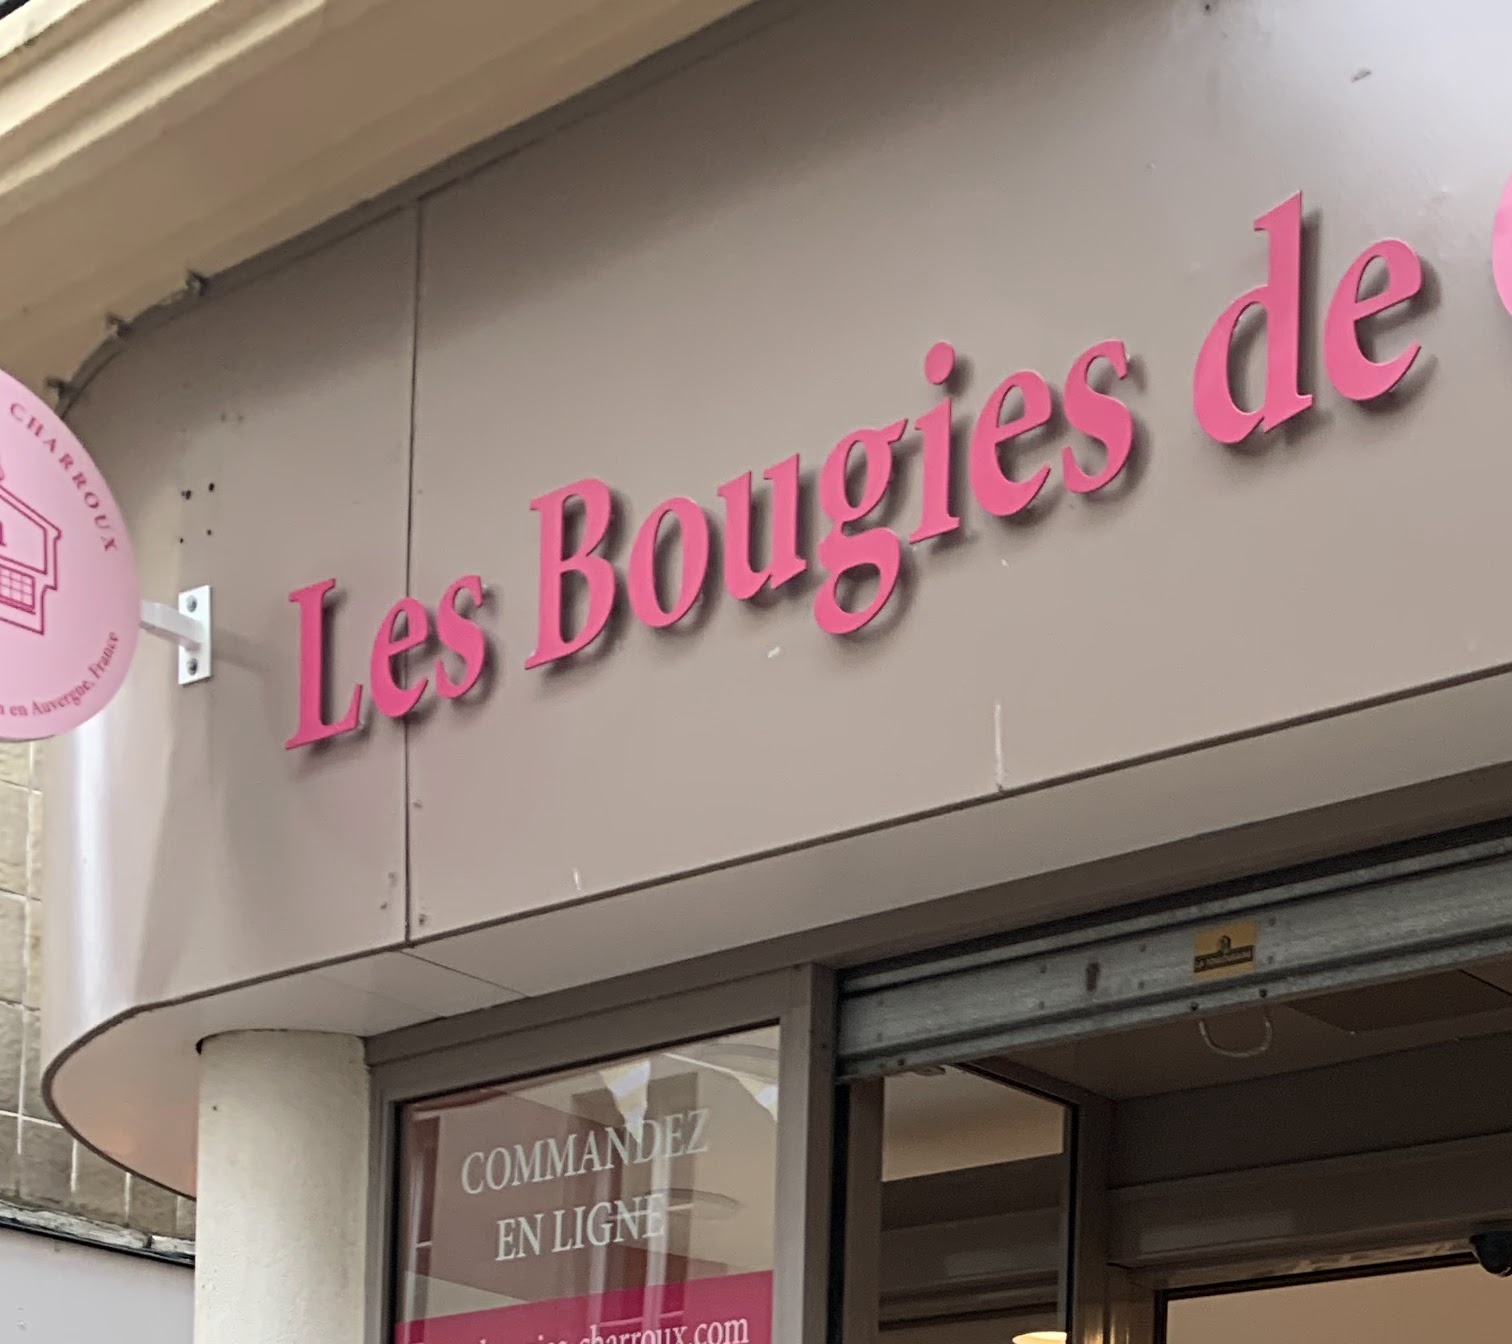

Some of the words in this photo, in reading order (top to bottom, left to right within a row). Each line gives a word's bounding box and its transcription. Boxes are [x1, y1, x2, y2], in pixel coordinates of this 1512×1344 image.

[9, 402, 118, 552] CHARROUX
[283, 573, 486, 750] Les
[523, 339, 1134, 671] Bougies
[1192, 190, 1422, 443] de
[461, 1107, 711, 1195] COMMANDEZ
[495, 1213, 542, 1262] EN
[551, 1192, 666, 1253] LIGNE
